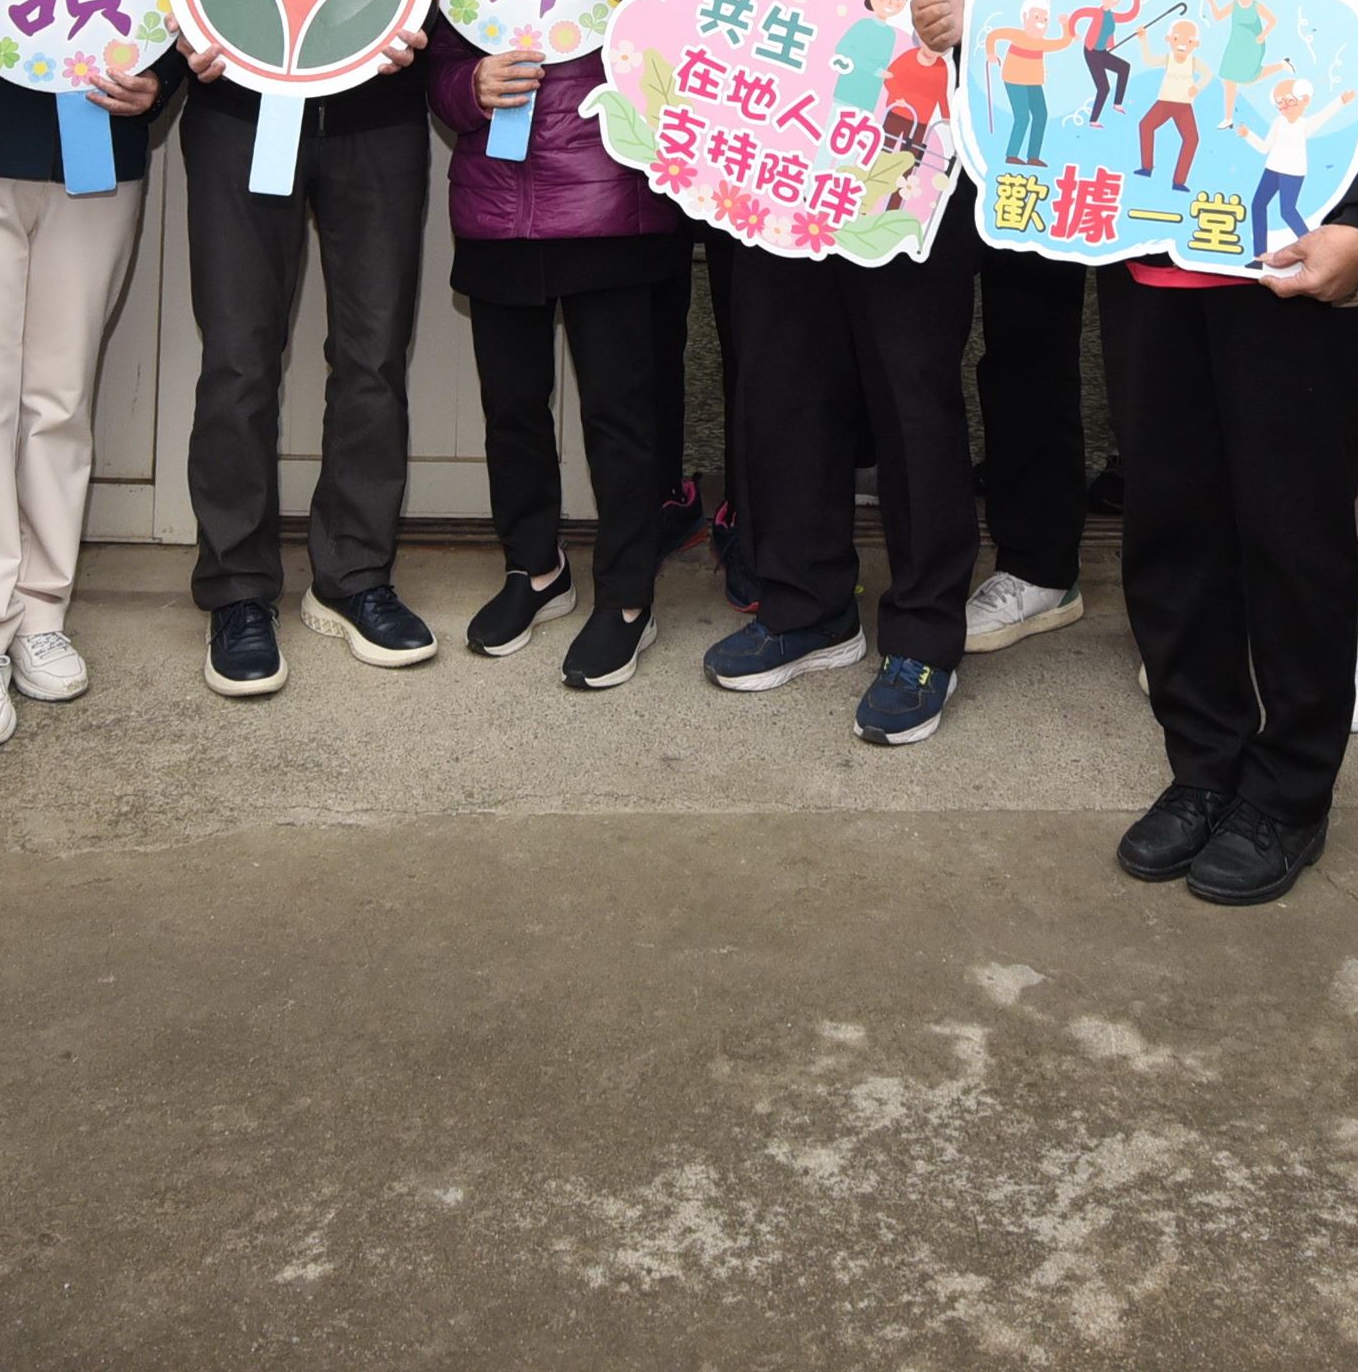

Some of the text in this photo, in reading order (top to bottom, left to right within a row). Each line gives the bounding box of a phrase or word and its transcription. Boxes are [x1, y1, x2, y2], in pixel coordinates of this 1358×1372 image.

[676, 47, 885, 168] 在地人的
[656, 108, 866, 226] 支持陪伴
[994, 164, 1247, 256] 歡據一堂
